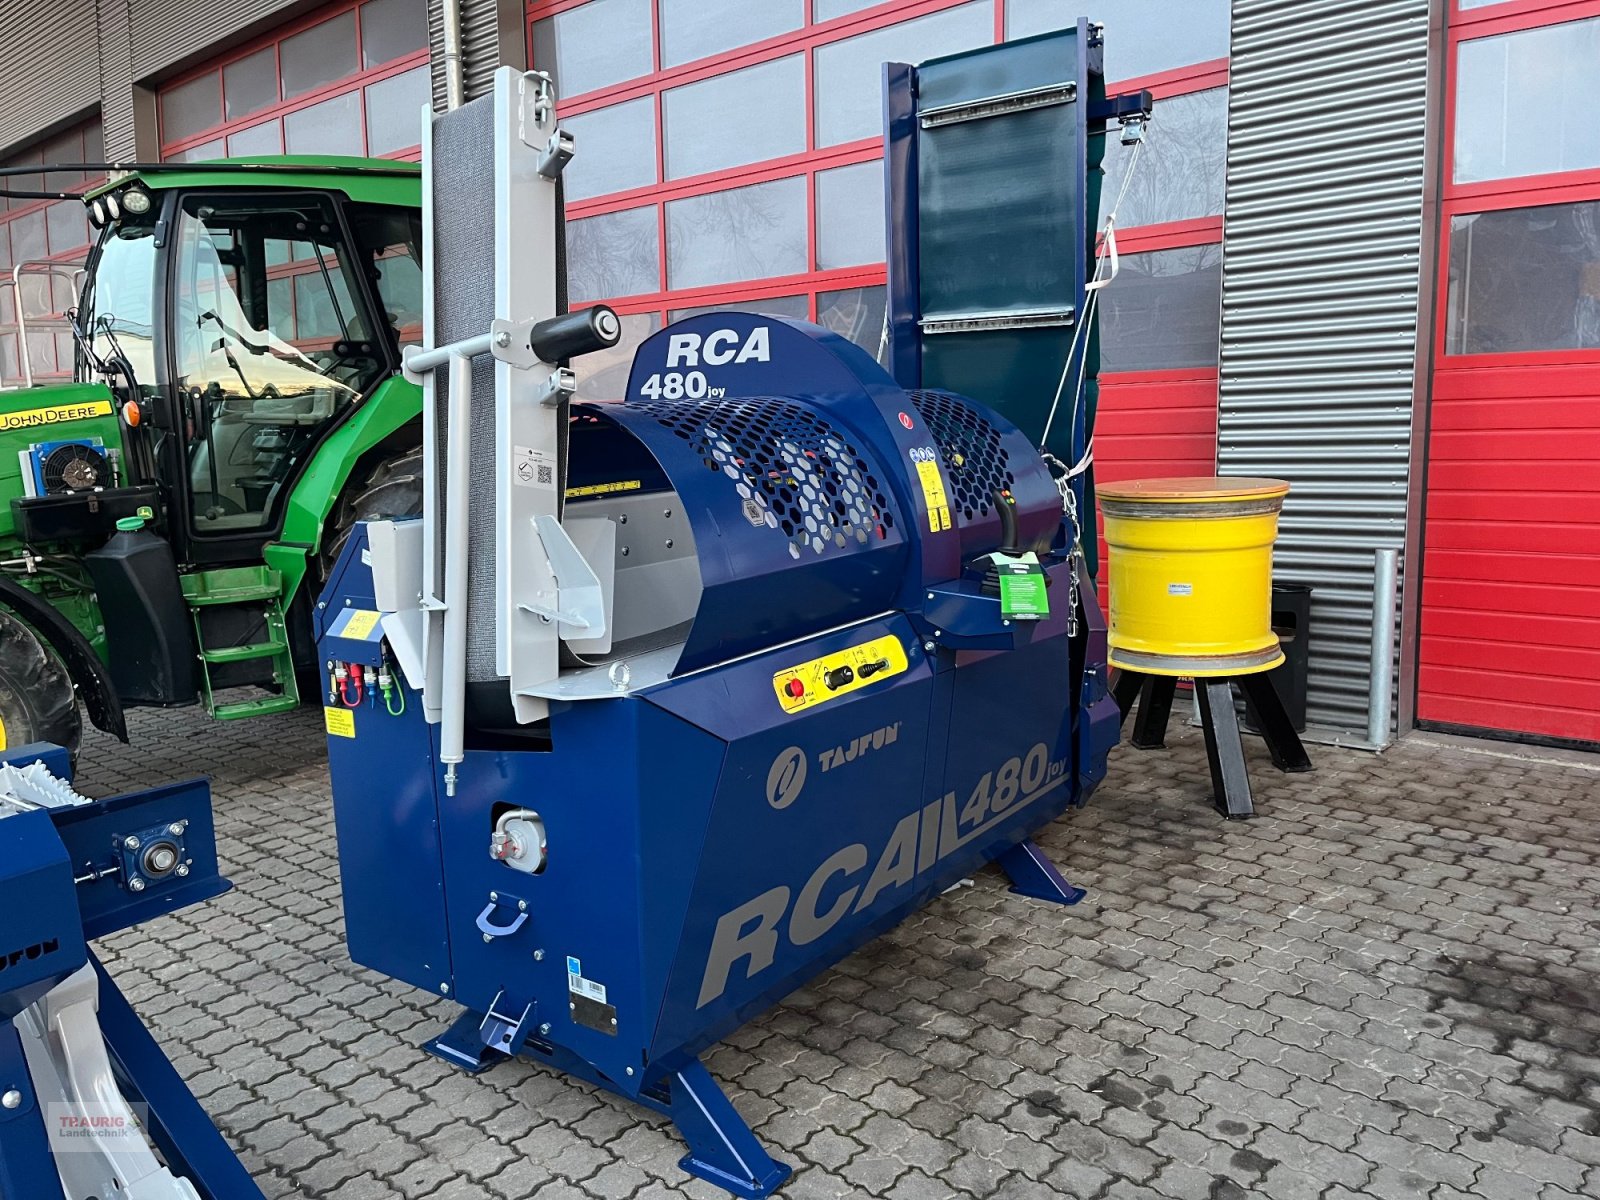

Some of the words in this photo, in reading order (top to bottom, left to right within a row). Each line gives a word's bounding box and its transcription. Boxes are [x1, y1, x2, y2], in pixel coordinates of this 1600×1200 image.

[666, 326, 770, 368] RCA
[1, 413, 43, 428] JOHN
[45, 406, 97, 421] DEERE
[818, 722, 898, 773] TAJFUN
